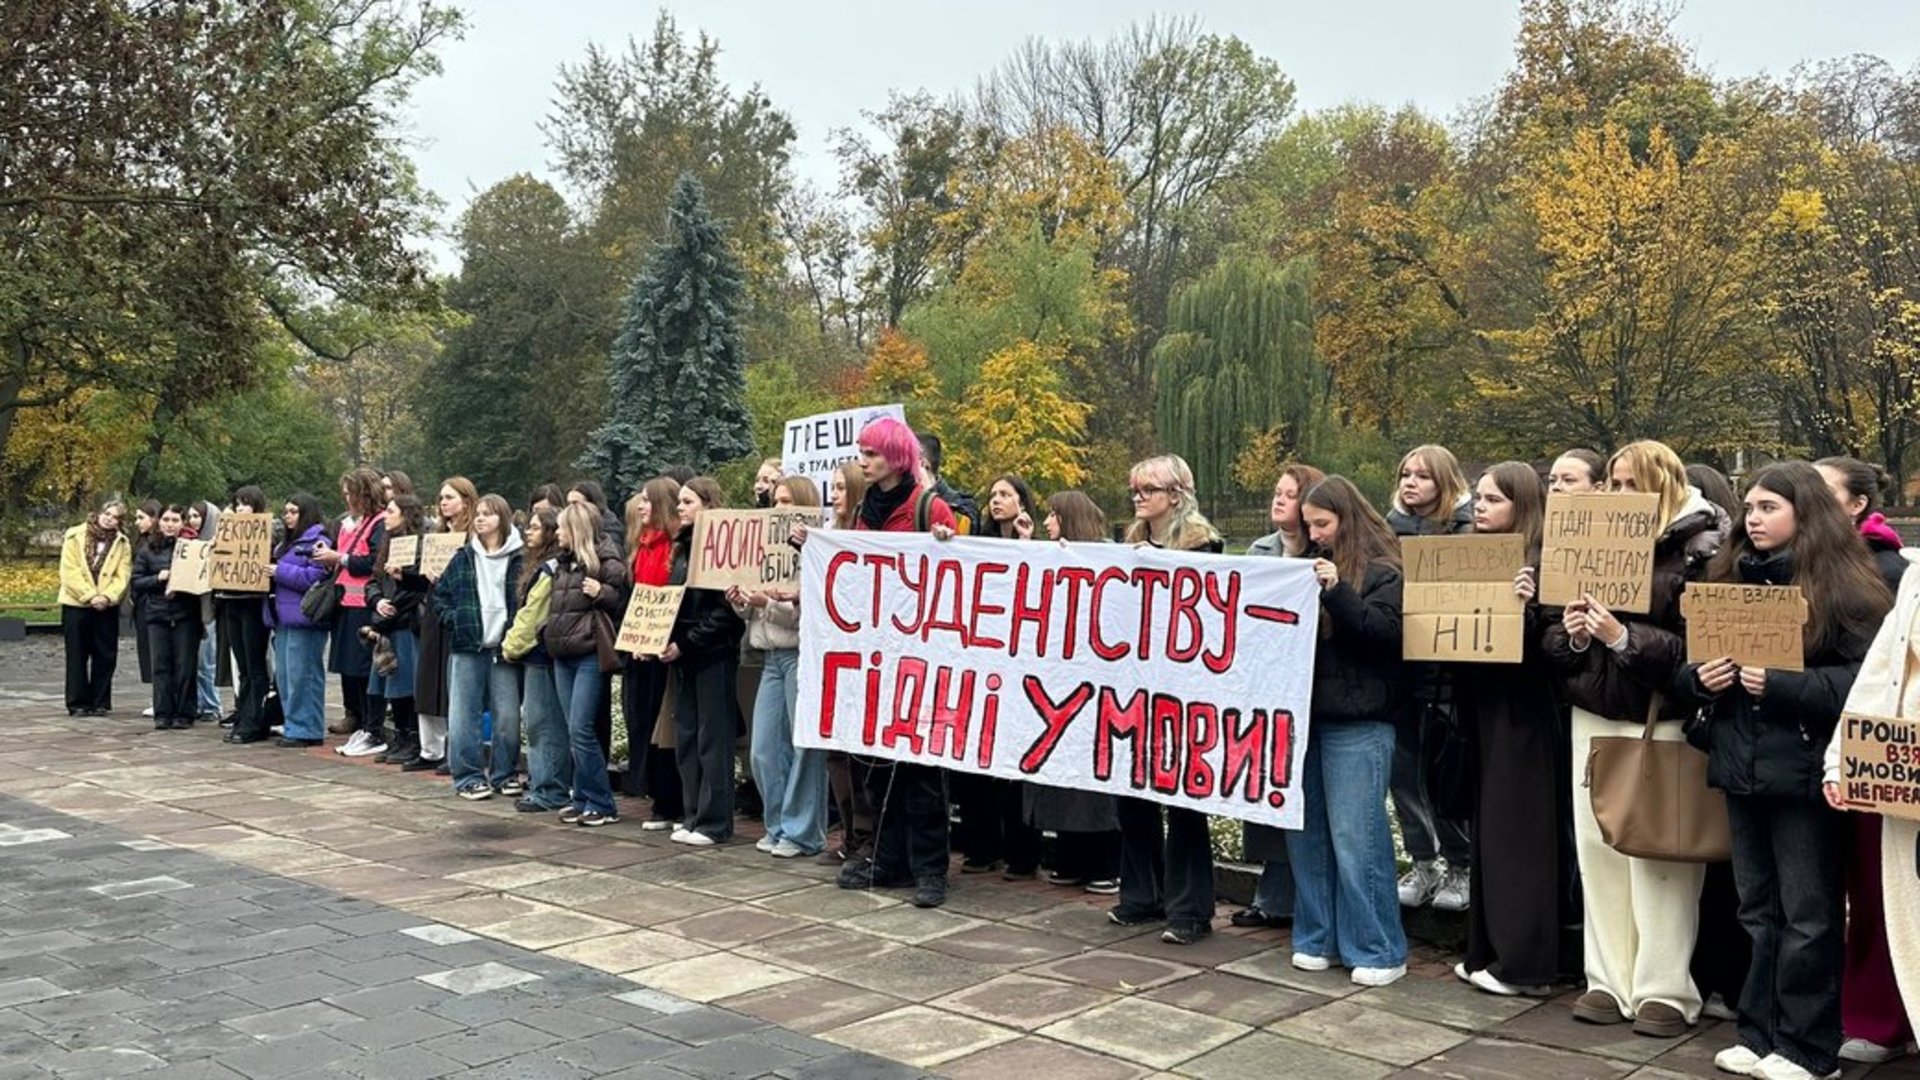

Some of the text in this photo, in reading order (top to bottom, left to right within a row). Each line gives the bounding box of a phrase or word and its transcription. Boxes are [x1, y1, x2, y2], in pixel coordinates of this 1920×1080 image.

[789, 417, 853, 454] ТРЕШ
[217, 518, 268, 542] РЕКТОРА
[1550, 510, 1592, 538] ГІДНІ
[1551, 547, 1649, 577] СТУДЕНТАМ
[1019, 674, 1294, 808] УМОВИ!
[1847, 719, 1916, 745] ГРОШІ
